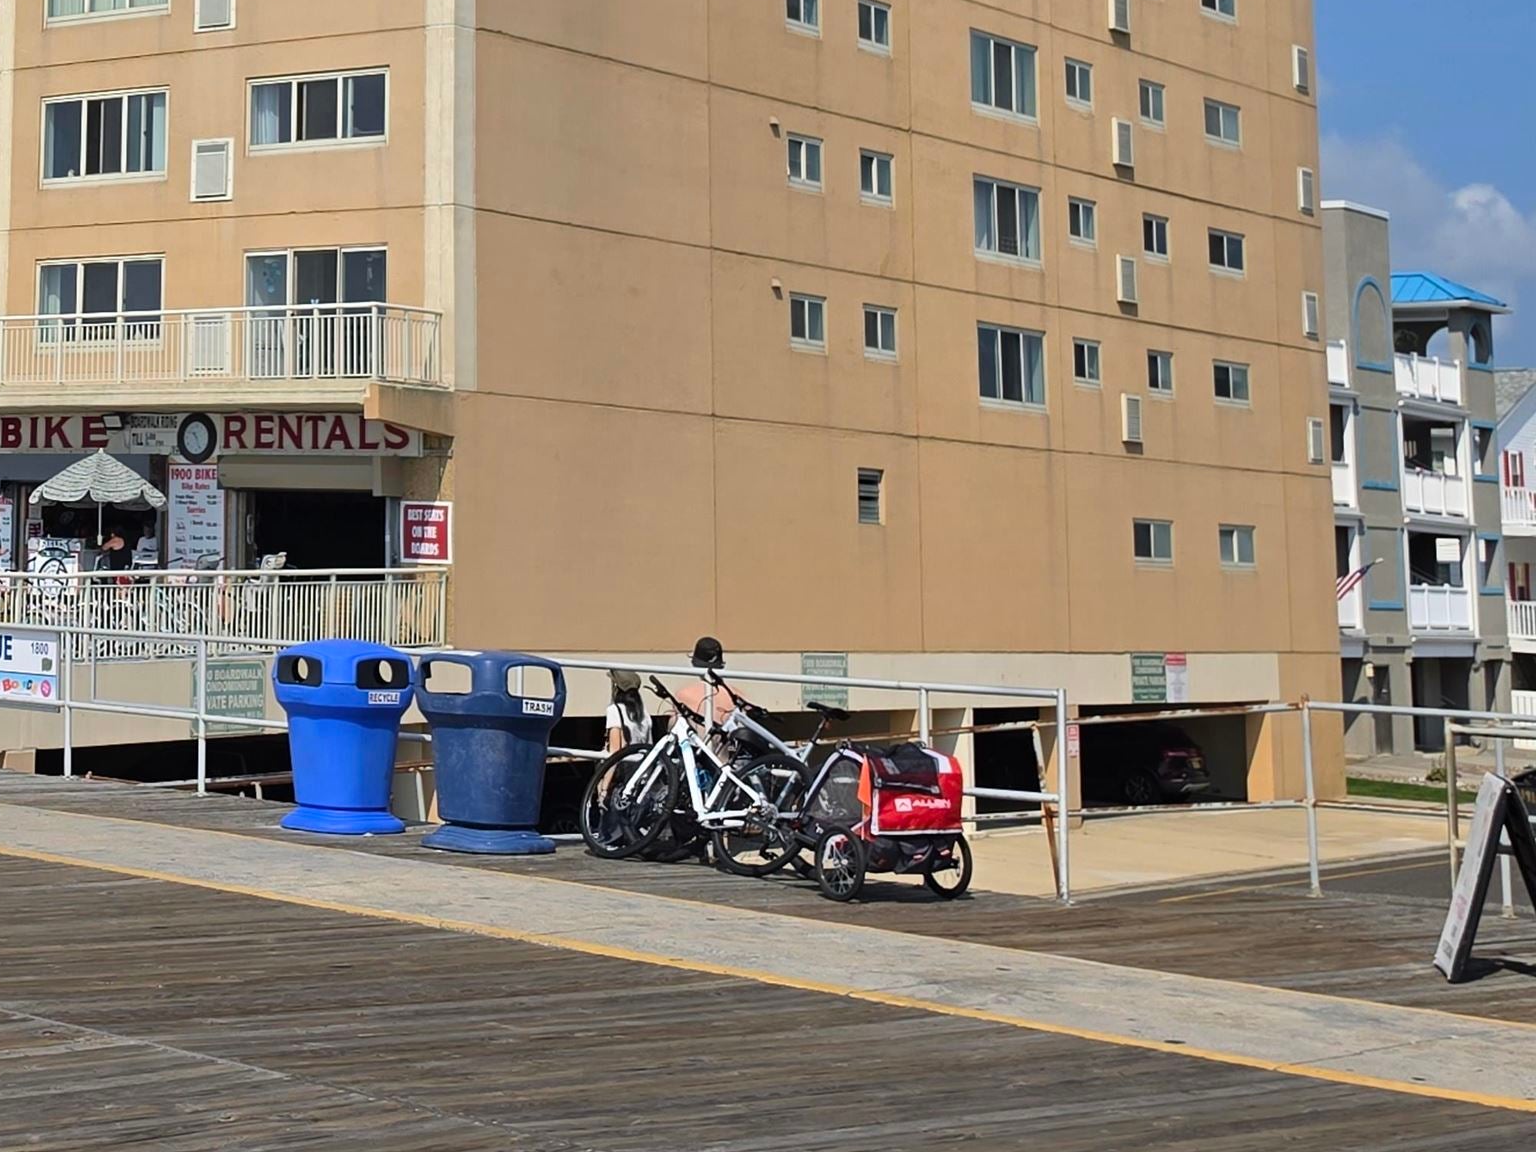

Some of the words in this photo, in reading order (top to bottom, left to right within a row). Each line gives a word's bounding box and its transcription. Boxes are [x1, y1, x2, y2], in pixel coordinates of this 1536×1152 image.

[0, 416, 109, 448] BIKE
[223, 414, 410, 450] RENTALS
[171, 469, 193, 480] 1900
[195, 469, 217, 480] BIKE
[30, 642, 49, 655] 1800
[214, 669, 263, 680] BOARDWALK
[228, 694, 264, 709] PARKING
[369, 693, 399, 704] RECYCLE
[525, 701, 552, 713] TRASH
